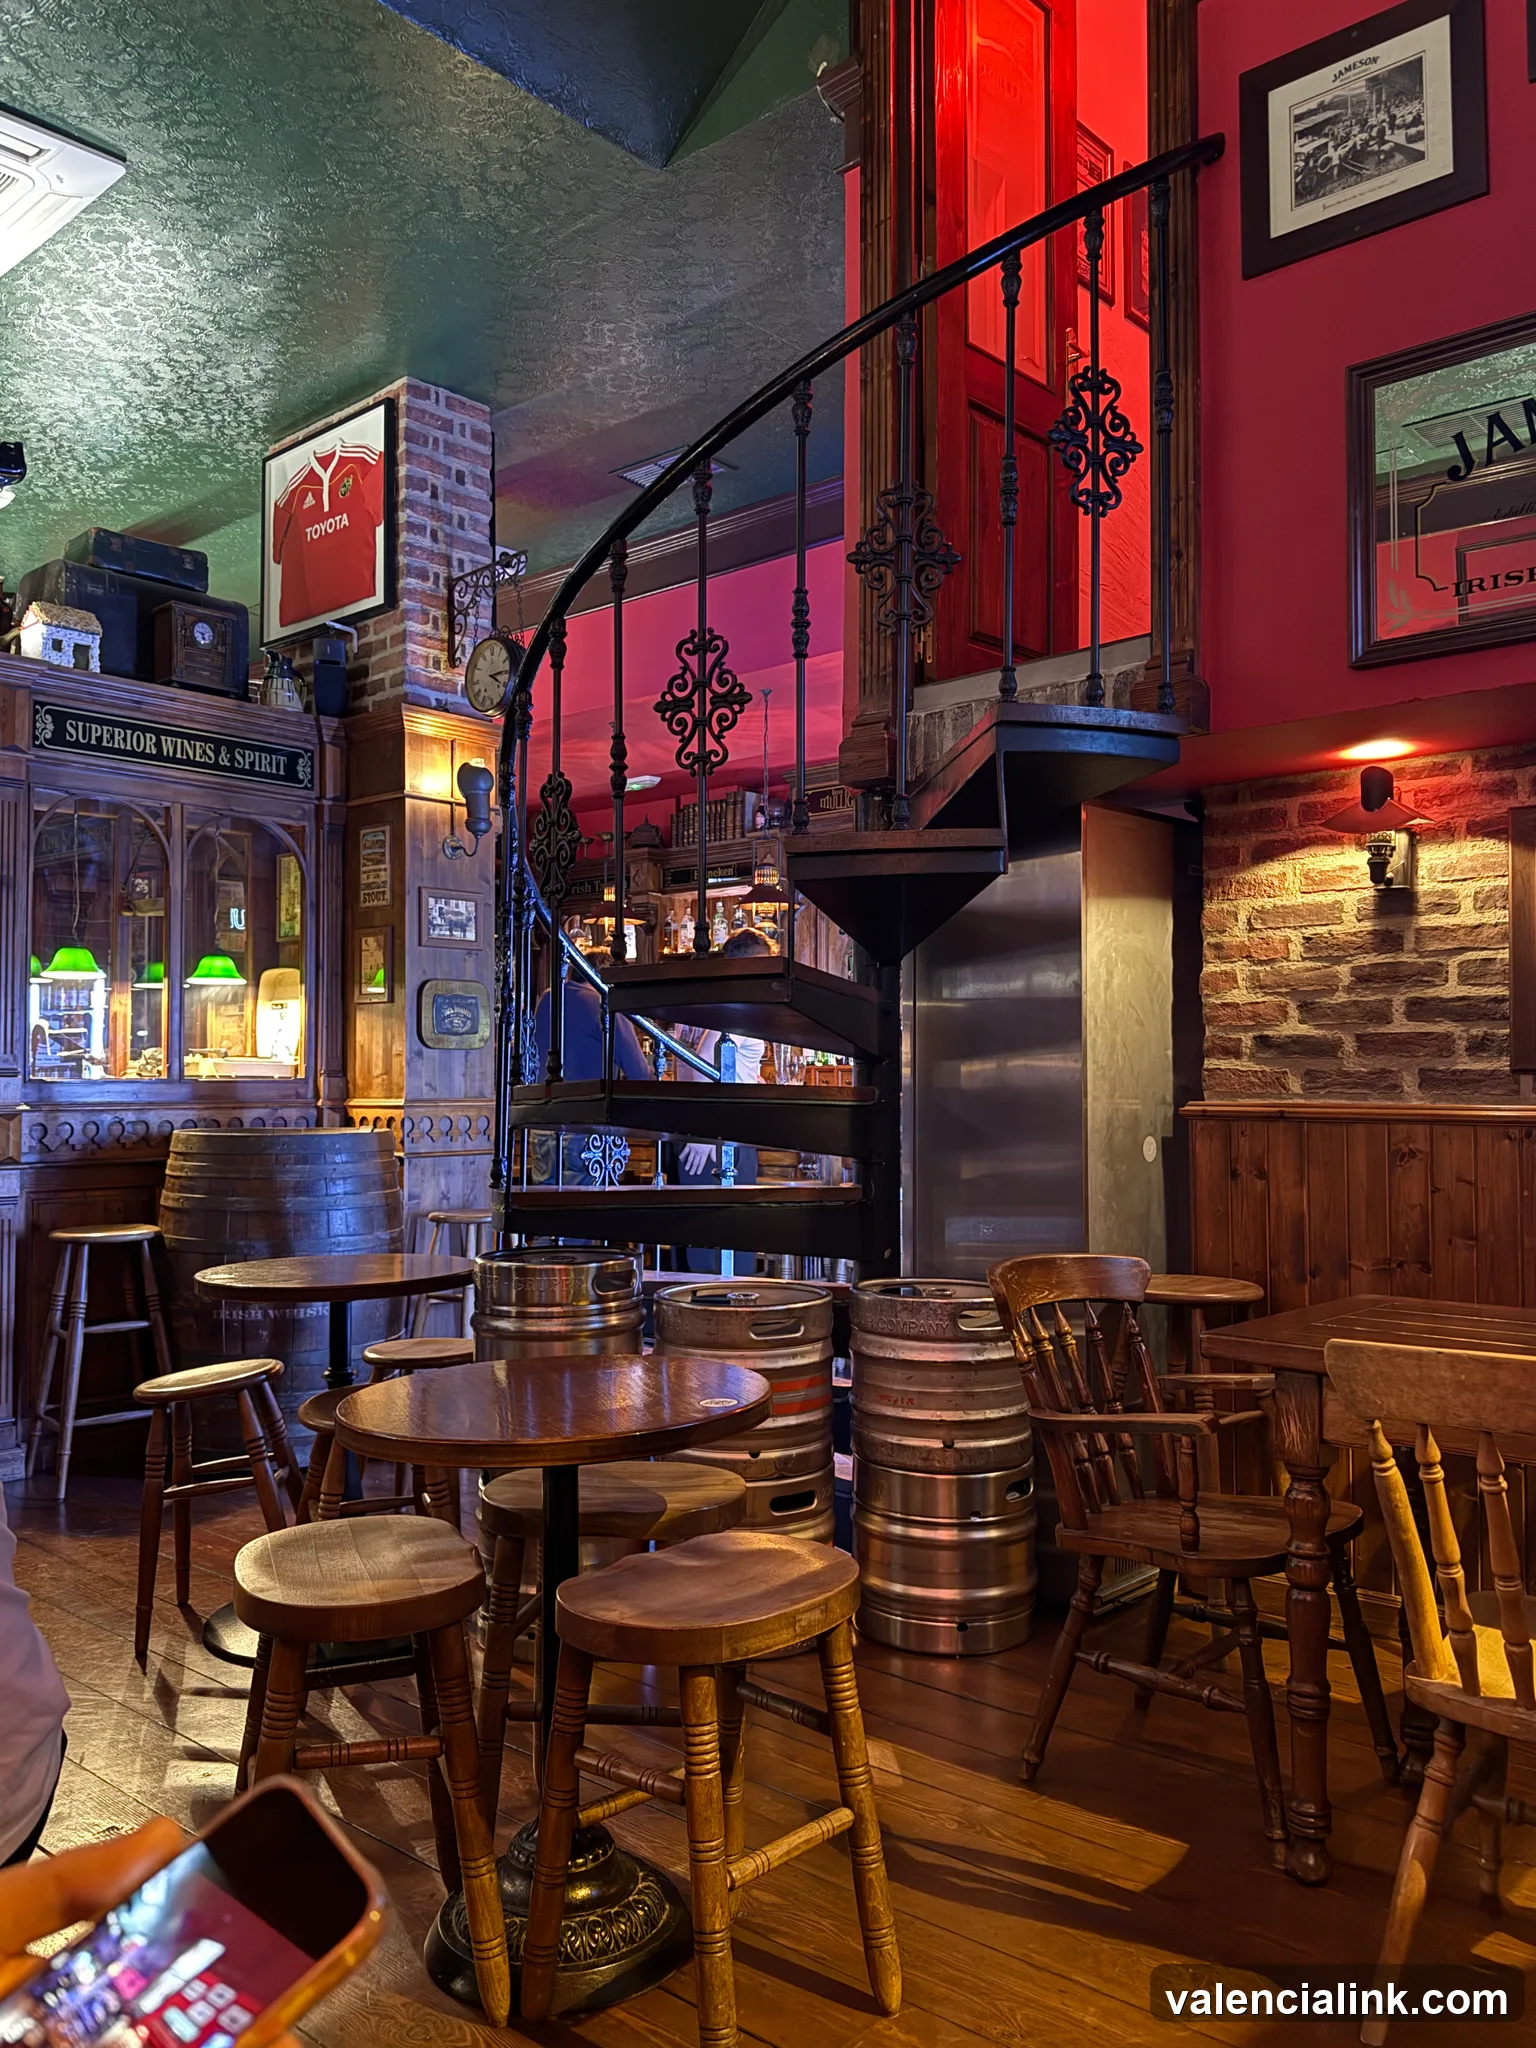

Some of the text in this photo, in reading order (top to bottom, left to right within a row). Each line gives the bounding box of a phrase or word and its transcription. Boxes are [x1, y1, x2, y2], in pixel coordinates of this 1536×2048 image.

[1332, 55, 1380, 83] JAMESON
[305, 512, 349, 542] TOYOTA
[65, 719, 288, 775] SUPERIOR WINES & SPIRIT
[694, 866, 734, 880] Hneken
[362, 890, 386, 904] STOUT
[571, 881, 591, 894] rish
[878, 1316, 950, 1335] COMPANY
